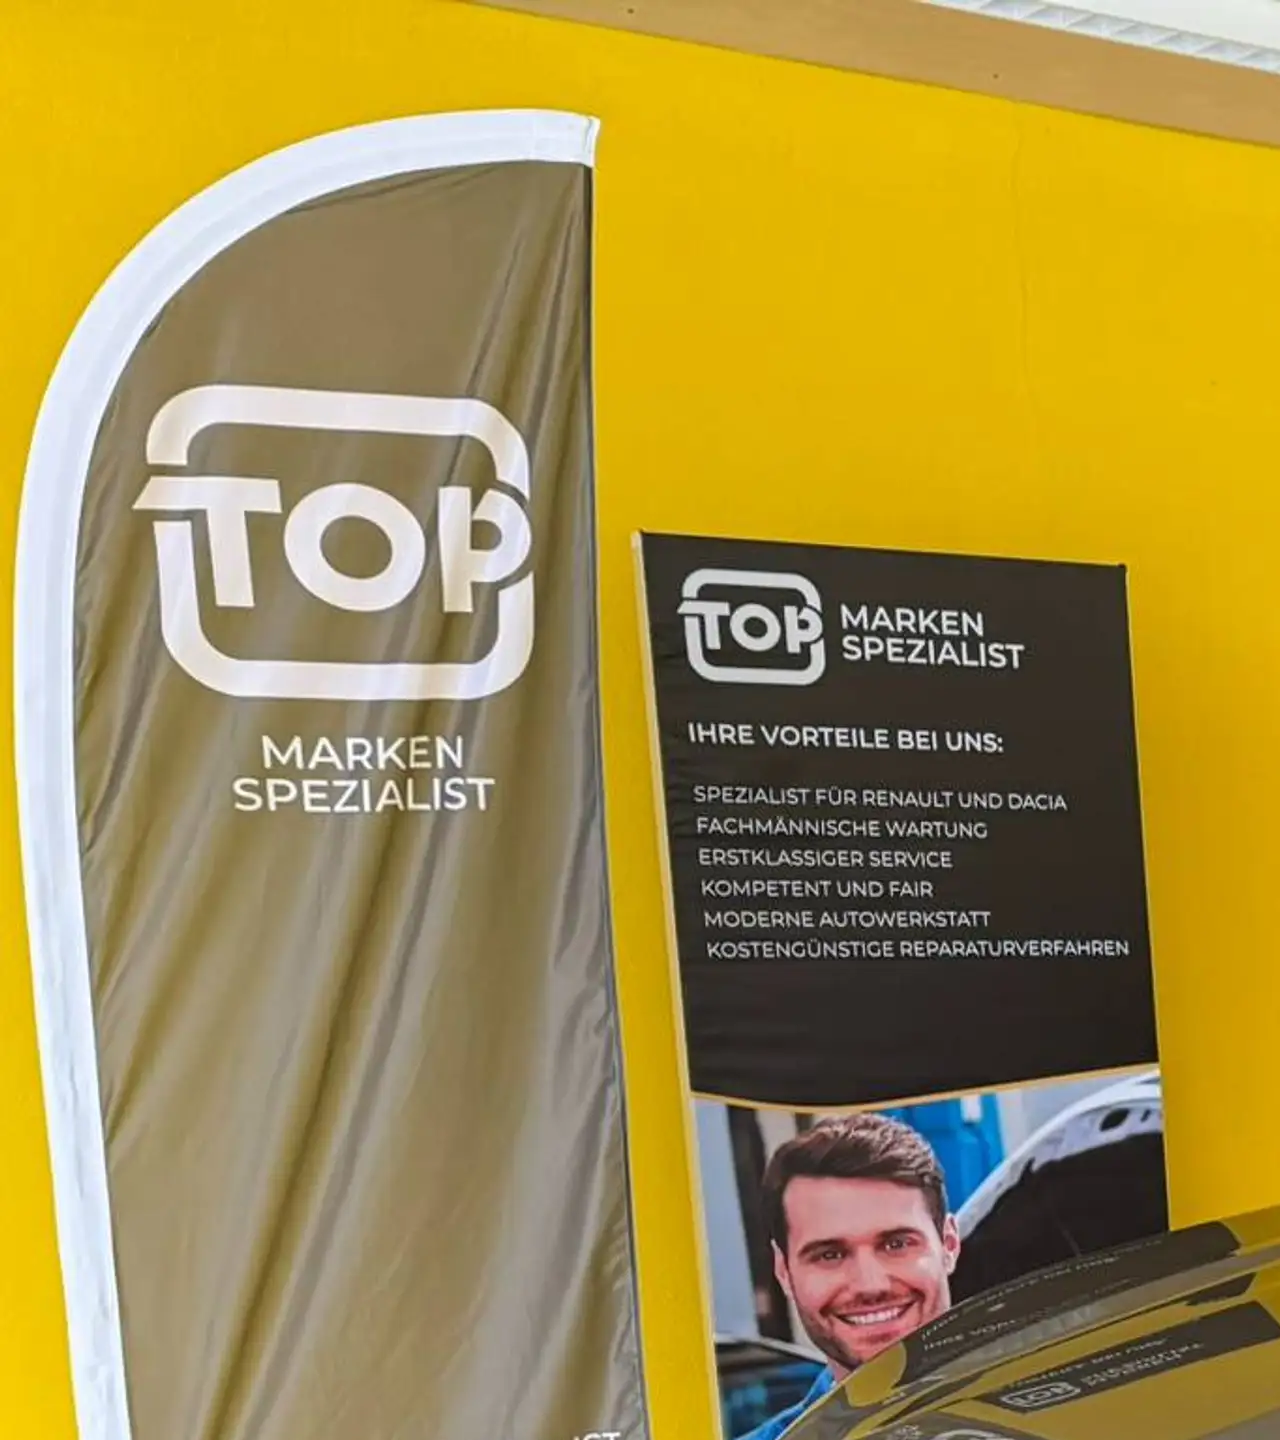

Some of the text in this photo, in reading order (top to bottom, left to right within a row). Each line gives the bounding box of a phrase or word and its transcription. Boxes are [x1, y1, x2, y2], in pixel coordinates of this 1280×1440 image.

[133, 476, 533, 613] TOP
[677, 600, 823, 654] TOP
[841, 603, 984, 638] MARKEN
[841, 636, 1025, 669] SPEZIALIST
[261, 734, 464, 772] MARKEN
[687, 722, 1004, 753] IHRE VORTEILE BEI UNS:
[232, 776, 496, 814] SPEZIALIST
[693, 784, 1068, 811] SPEZIALIST FÜR RENAULT UND DACIA
[697, 814, 988, 839] FACHMÄNNISCHE WARTUNG
[698, 848, 953, 869] ERSTKLASSIGER SERVICE
[701, 879, 934, 899] KOMPETENT UND FAIR
[704, 910, 991, 929] MODERNE AUTOWERKSTATT
[706, 938, 1130, 959] KOSTENGÜNSTIGE REPARATURVERFAHREN
